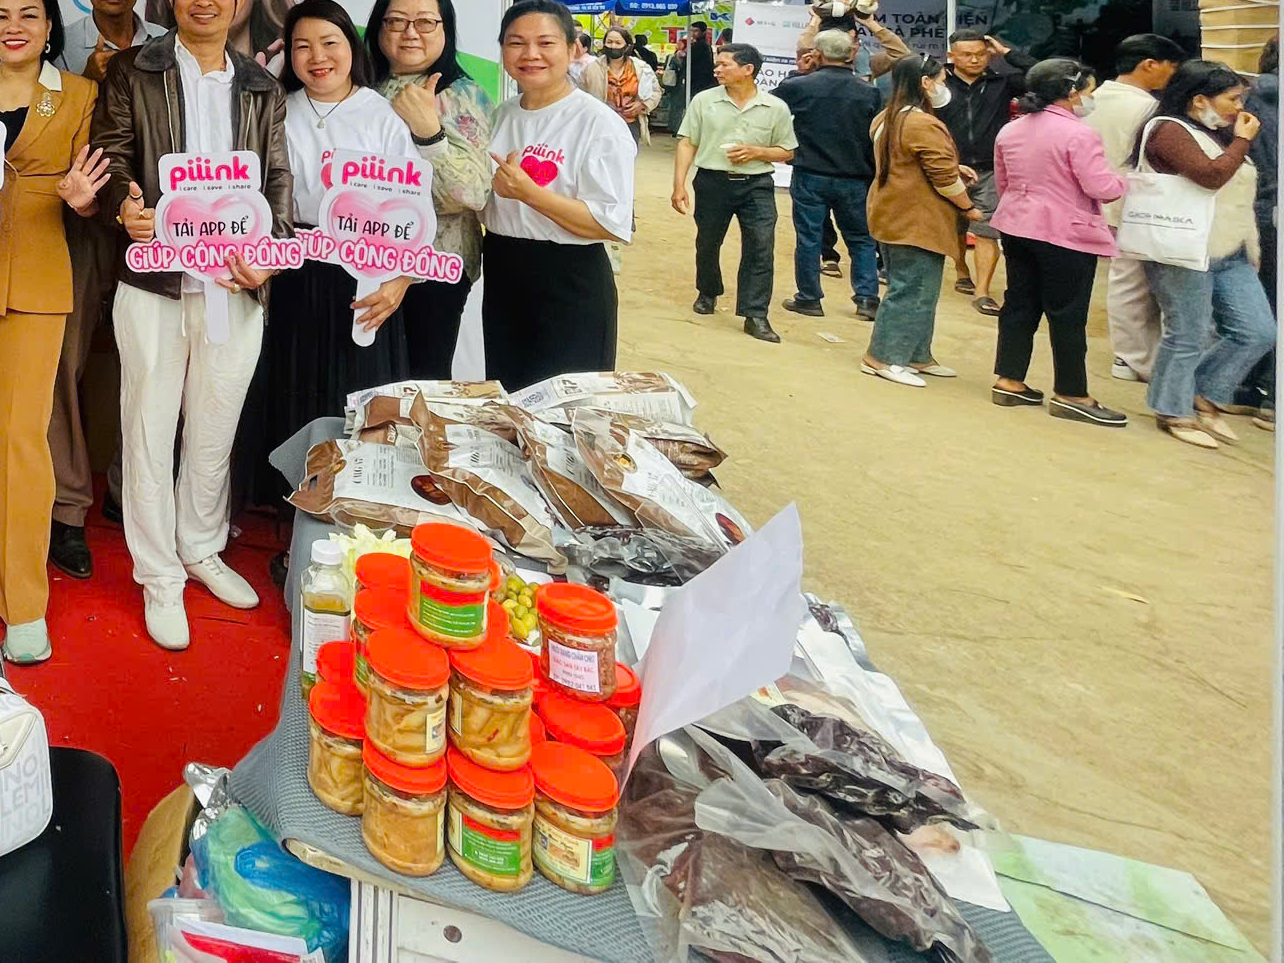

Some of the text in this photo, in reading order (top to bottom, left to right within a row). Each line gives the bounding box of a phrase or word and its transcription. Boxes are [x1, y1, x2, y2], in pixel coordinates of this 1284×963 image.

[169, 155, 251, 191] piiink
[342, 155, 422, 187] piiink
[200, 221, 226, 236] APP
[230, 215, 249, 235] ĐỂ
[362, 220, 390, 237] APP
[394, 221, 415, 240] ĐỂ
[242, 237, 303, 267] ĐỒNG
[339, 238, 398, 270] CỘNG
[400, 244, 463, 281] ĐỒNG
